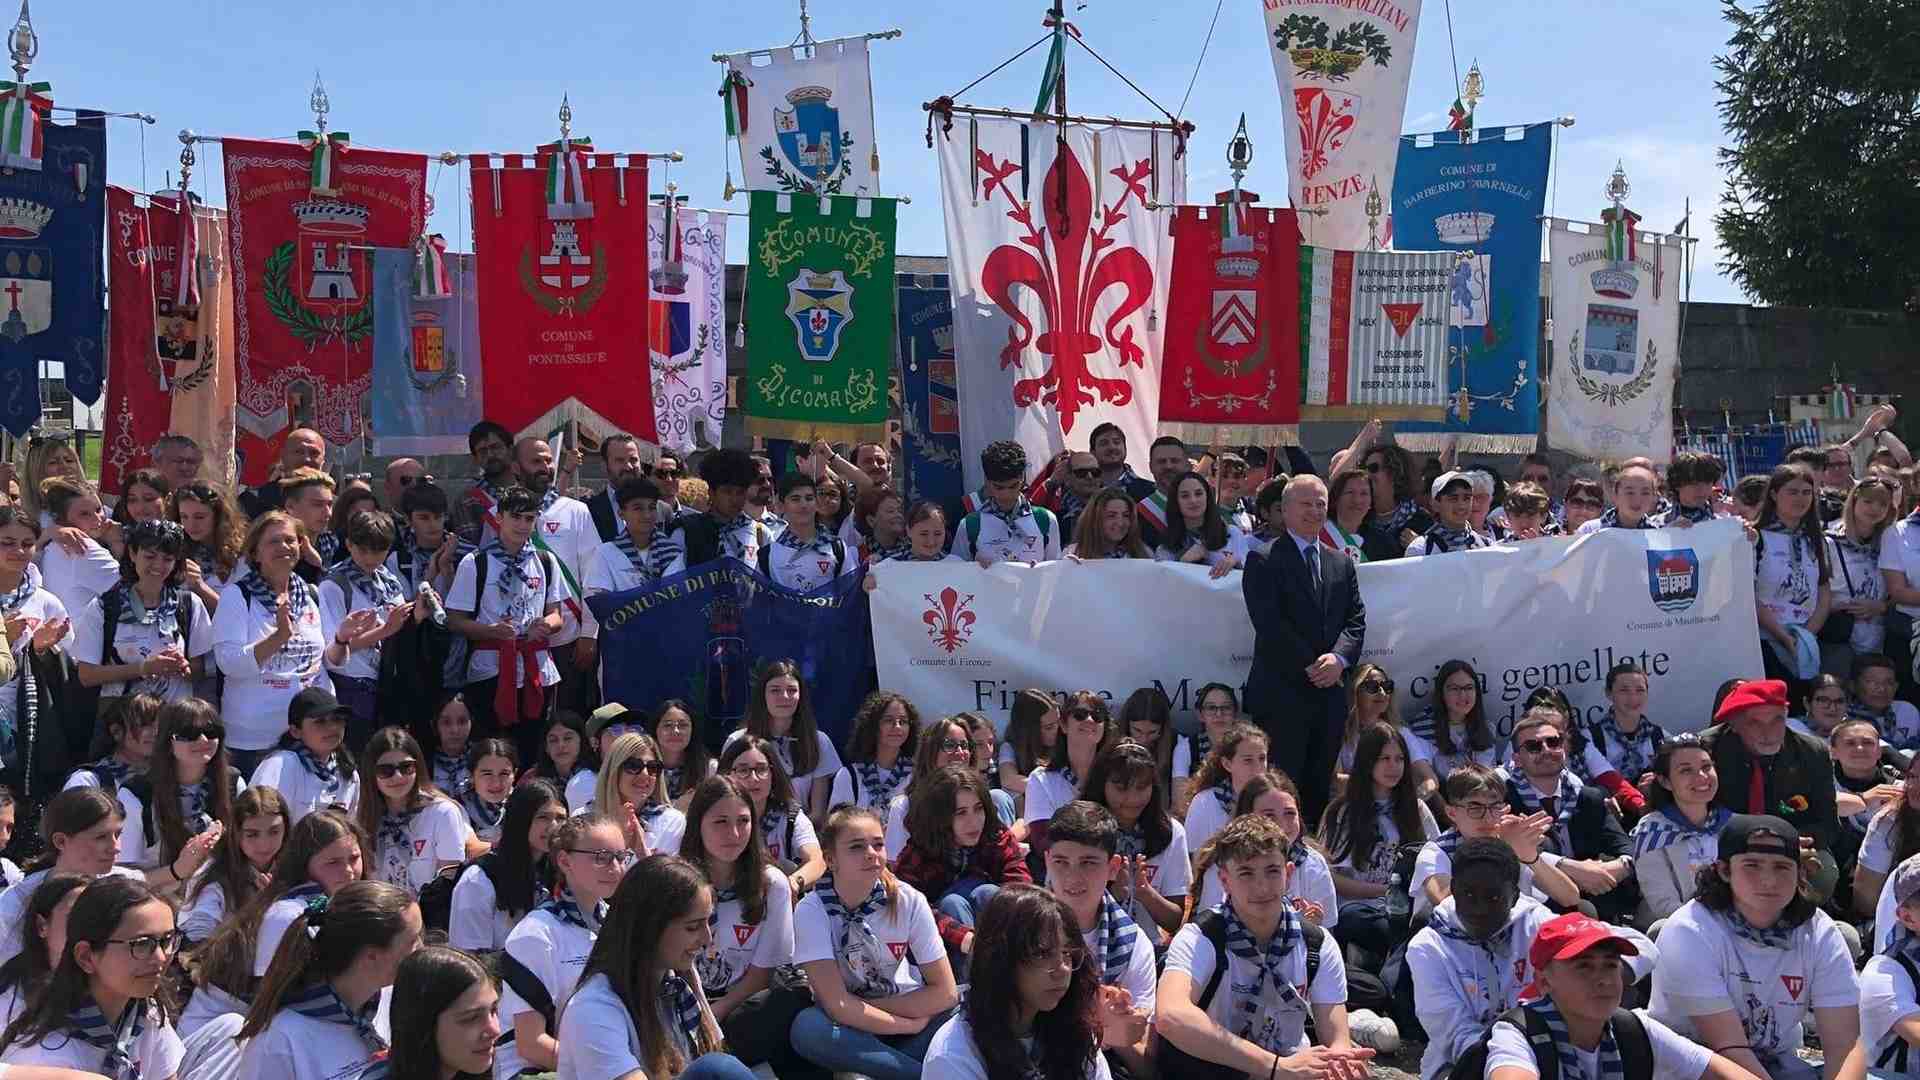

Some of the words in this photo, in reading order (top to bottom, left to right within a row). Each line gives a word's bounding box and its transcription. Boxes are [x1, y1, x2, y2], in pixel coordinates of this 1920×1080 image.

[1440, 163, 1483, 176] COMUNE
[1486, 163, 1497, 173] DI
[1403, 180, 1465, 208] BARBERINO
[779, 218, 865, 255] COMUNE
[1567, 249, 1608, 268] COMUN
[1359, 284, 1397, 293] AUSCHWITZ
[1358, 318, 1377, 327] MELK
[541, 329, 594, 342] COMUNE
[604, 583, 681, 631] COMUNE
[684, 575, 705, 593] DI
[1626, 620, 1663, 632] Comune
[910, 656, 946, 666] Comune
[948, 656, 957, 666] di
[959, 656, 992, 667] Firenze
